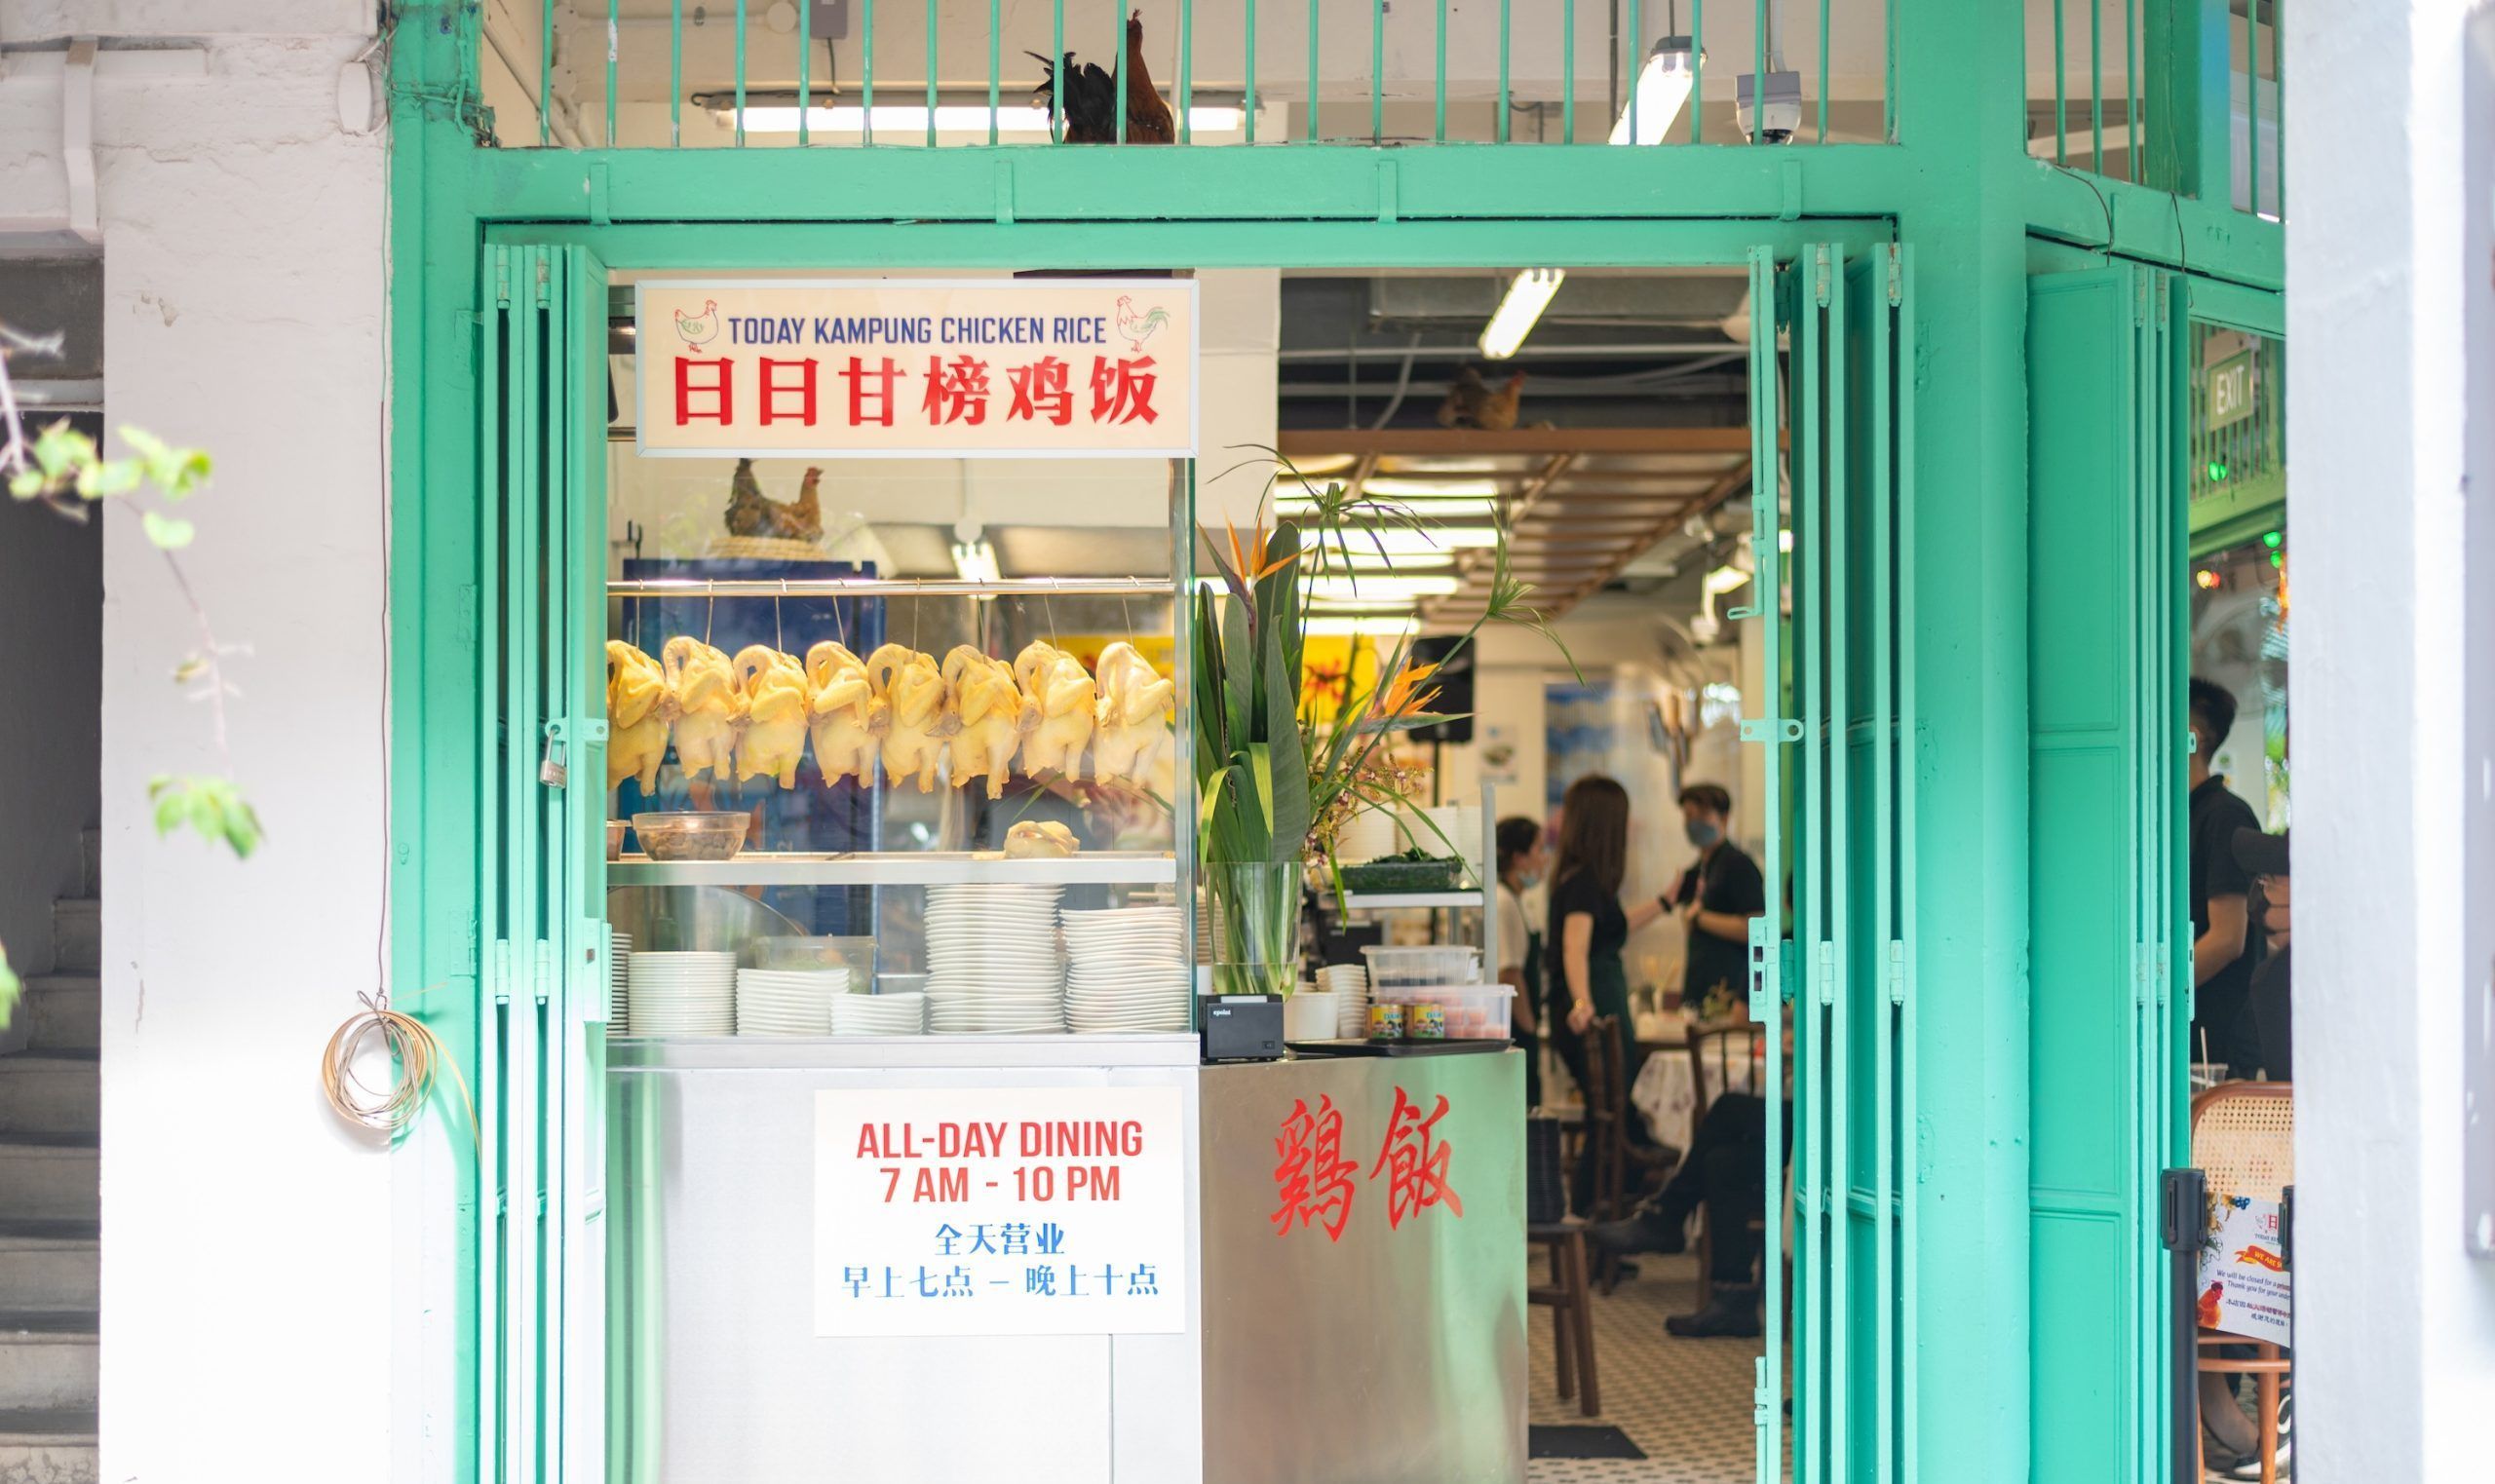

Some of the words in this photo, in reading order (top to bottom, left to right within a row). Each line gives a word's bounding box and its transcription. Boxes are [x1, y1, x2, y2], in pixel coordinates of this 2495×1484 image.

[728, 317, 805, 344] TODAY
[814, 317, 933, 343] KAMPUNG
[940, 317, 1045, 344] CHICKEN
[1053, 317, 1107, 344] RICE
[674, 354, 1160, 427] 日日甘榜鸡饭
[2216, 365, 2245, 415] EXIT
[857, 1122, 1008, 1160] ALL-DAY
[1019, 1120, 1143, 1159] DINING
[880, 1168, 902, 1203] 7
[913, 1167, 970, 1202] AM
[1013, 1166, 1054, 1202] 10
[1067, 1166, 1121, 1201] PM
[935, 1222, 1066, 1256] 全天营业
[2254, 1250, 2264, 1260] WE
[2264, 1256, 2277, 1267] ARE
[841, 1265, 975, 1299] 早上七点
[1025, 1263, 1160, 1296] 晚上十点
[2228, 1280, 2246, 1289] Thank
[2246, 1275, 2264, 1284] closed
